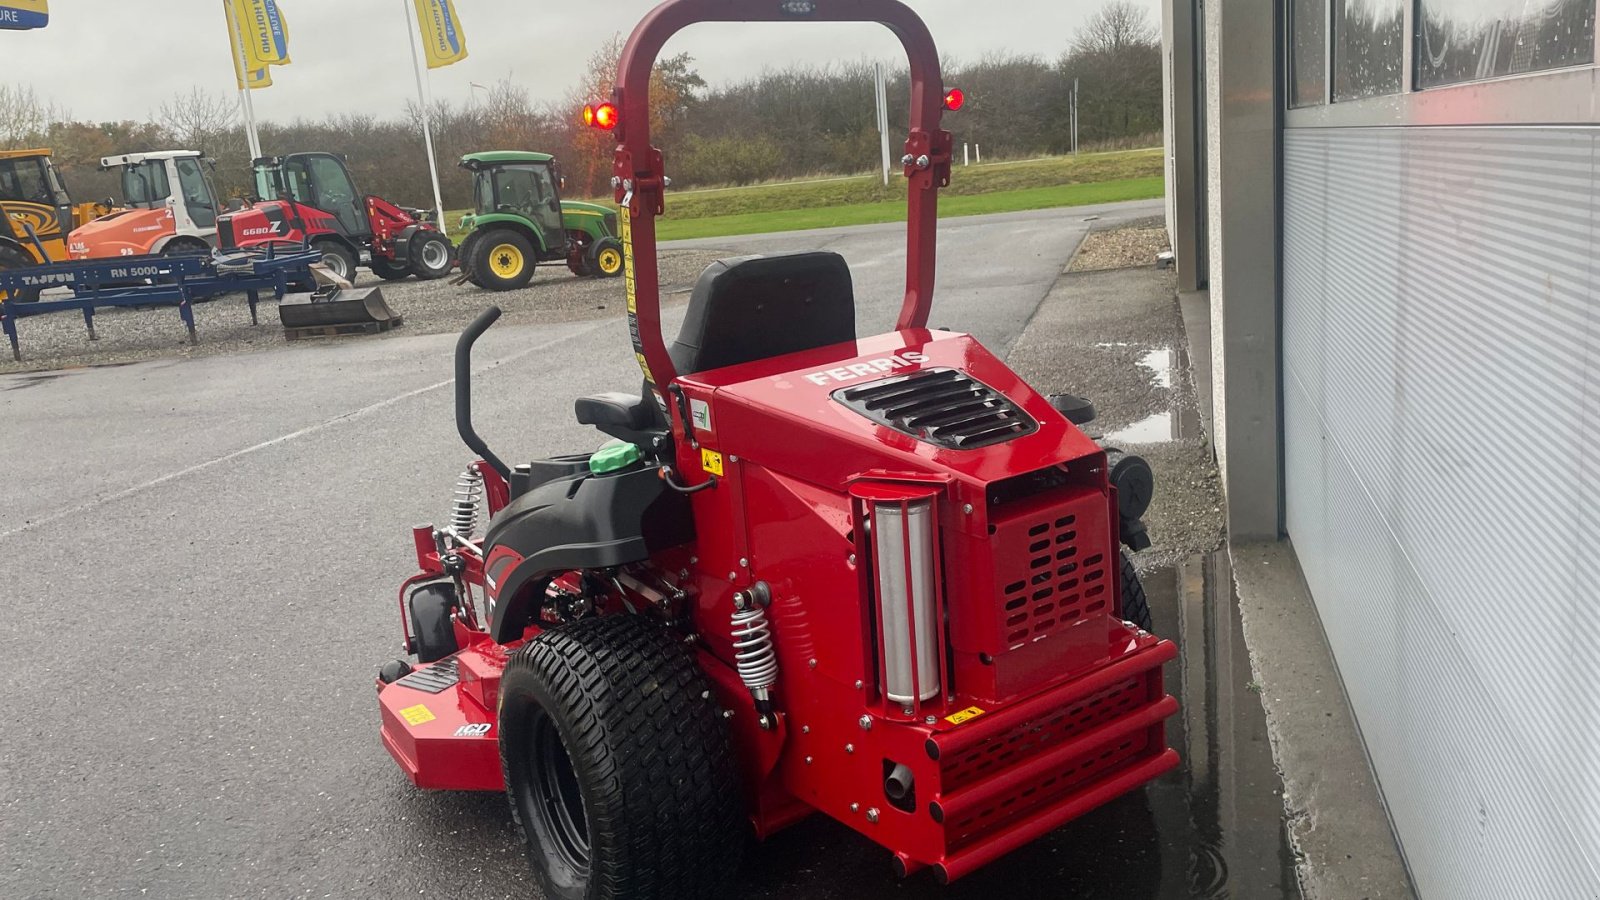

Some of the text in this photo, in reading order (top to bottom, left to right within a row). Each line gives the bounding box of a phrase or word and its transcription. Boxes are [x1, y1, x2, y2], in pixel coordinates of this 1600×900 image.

[269, 220, 282, 233] Z
[120, 247, 134, 256] 95
[110, 266, 158, 278] RN 5000
[21, 272, 75, 286] TAJFUN
[804, 351, 930, 386] FERRIS
